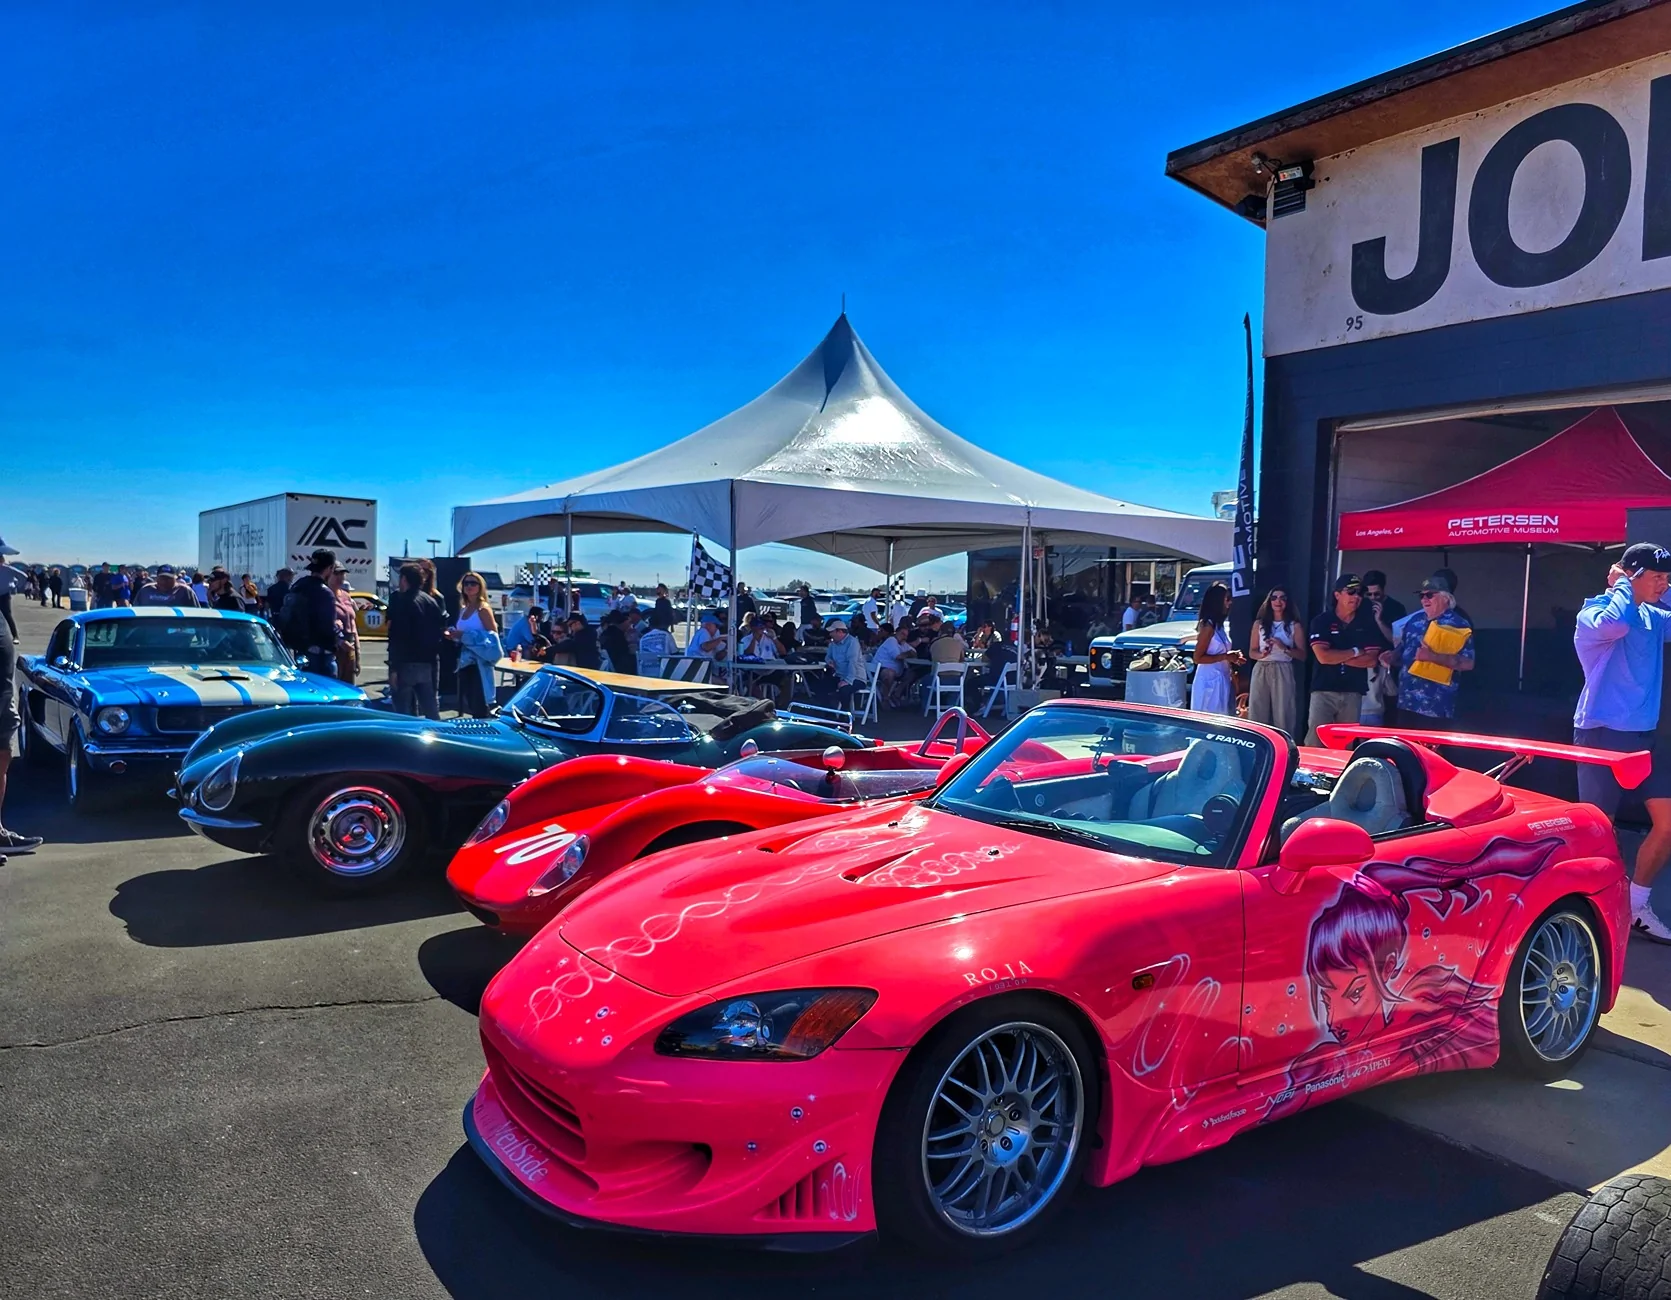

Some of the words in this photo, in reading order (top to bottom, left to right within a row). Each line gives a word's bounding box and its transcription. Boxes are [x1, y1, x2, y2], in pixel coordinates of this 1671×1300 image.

[1351, 74, 1671, 315] JO
[1345, 315, 1364, 332] 95
[1447, 514, 1559, 530] PETERSEN
[1448, 527, 1510, 537] AUTOMOTIVE
[367, 614, 380, 625] 111
[1215, 734, 1256, 749] RAYNO
[1527, 816, 1573, 831] PETERSEN
[1305, 1074, 1346, 1094] Panasonic
[496, 1119, 550, 1182] VeilSide
